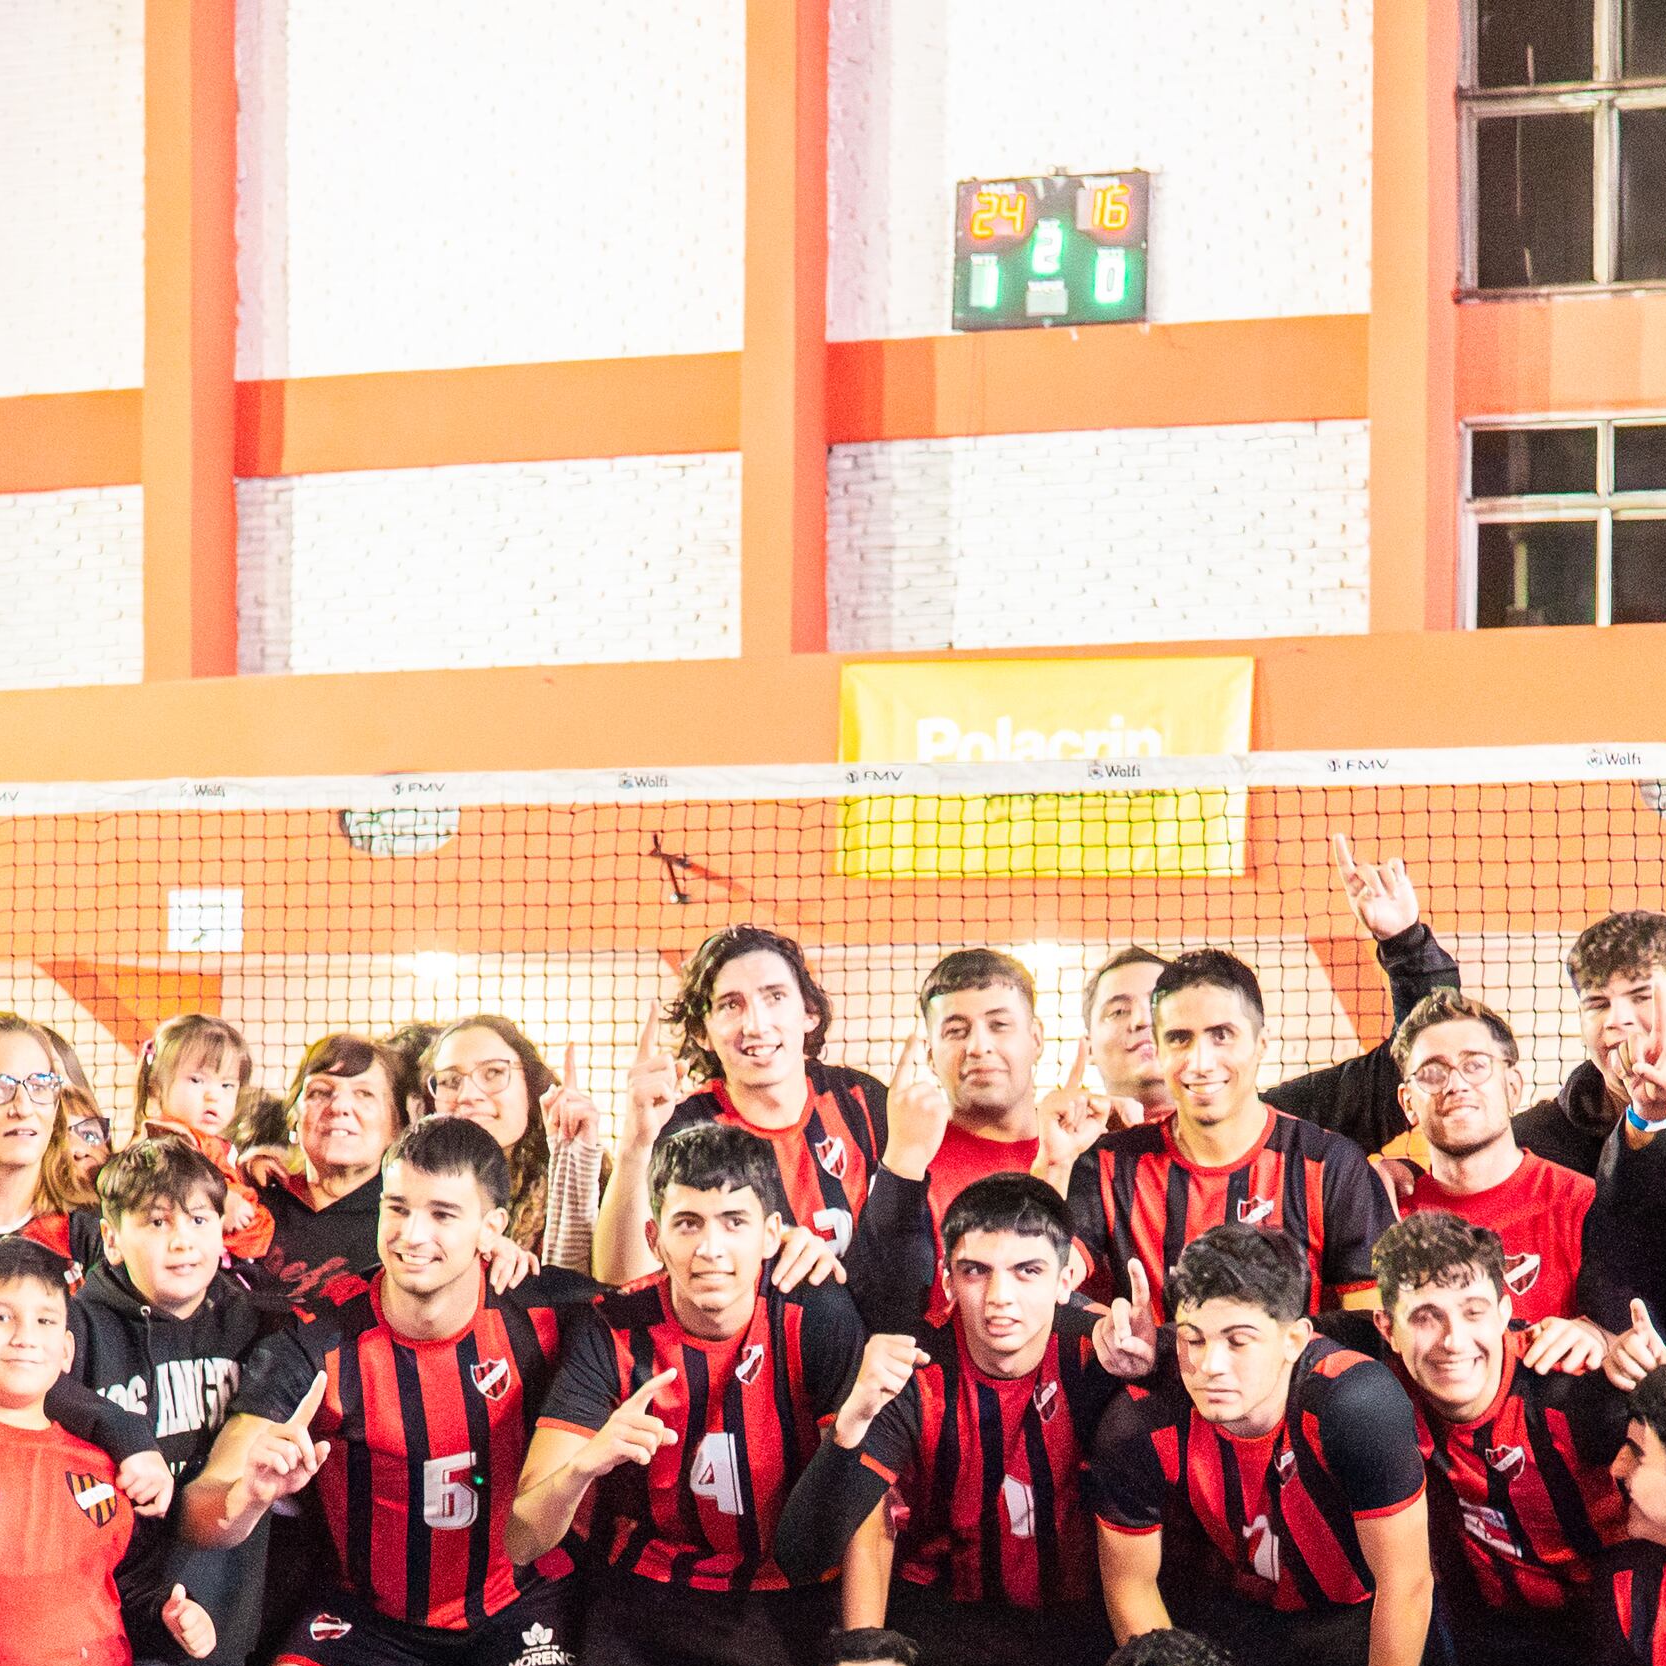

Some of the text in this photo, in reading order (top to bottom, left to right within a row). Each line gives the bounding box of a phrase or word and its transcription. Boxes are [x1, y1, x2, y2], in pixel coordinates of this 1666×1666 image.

[971, 185, 1129, 238] 24 16
[1095, 253, 1125, 303] 0
[864, 770, 904, 782] FMV
[1346, 759, 1389, 770] FMV
[408, 783, 446, 793] FMV
[690, 1432, 743, 1515] 4
